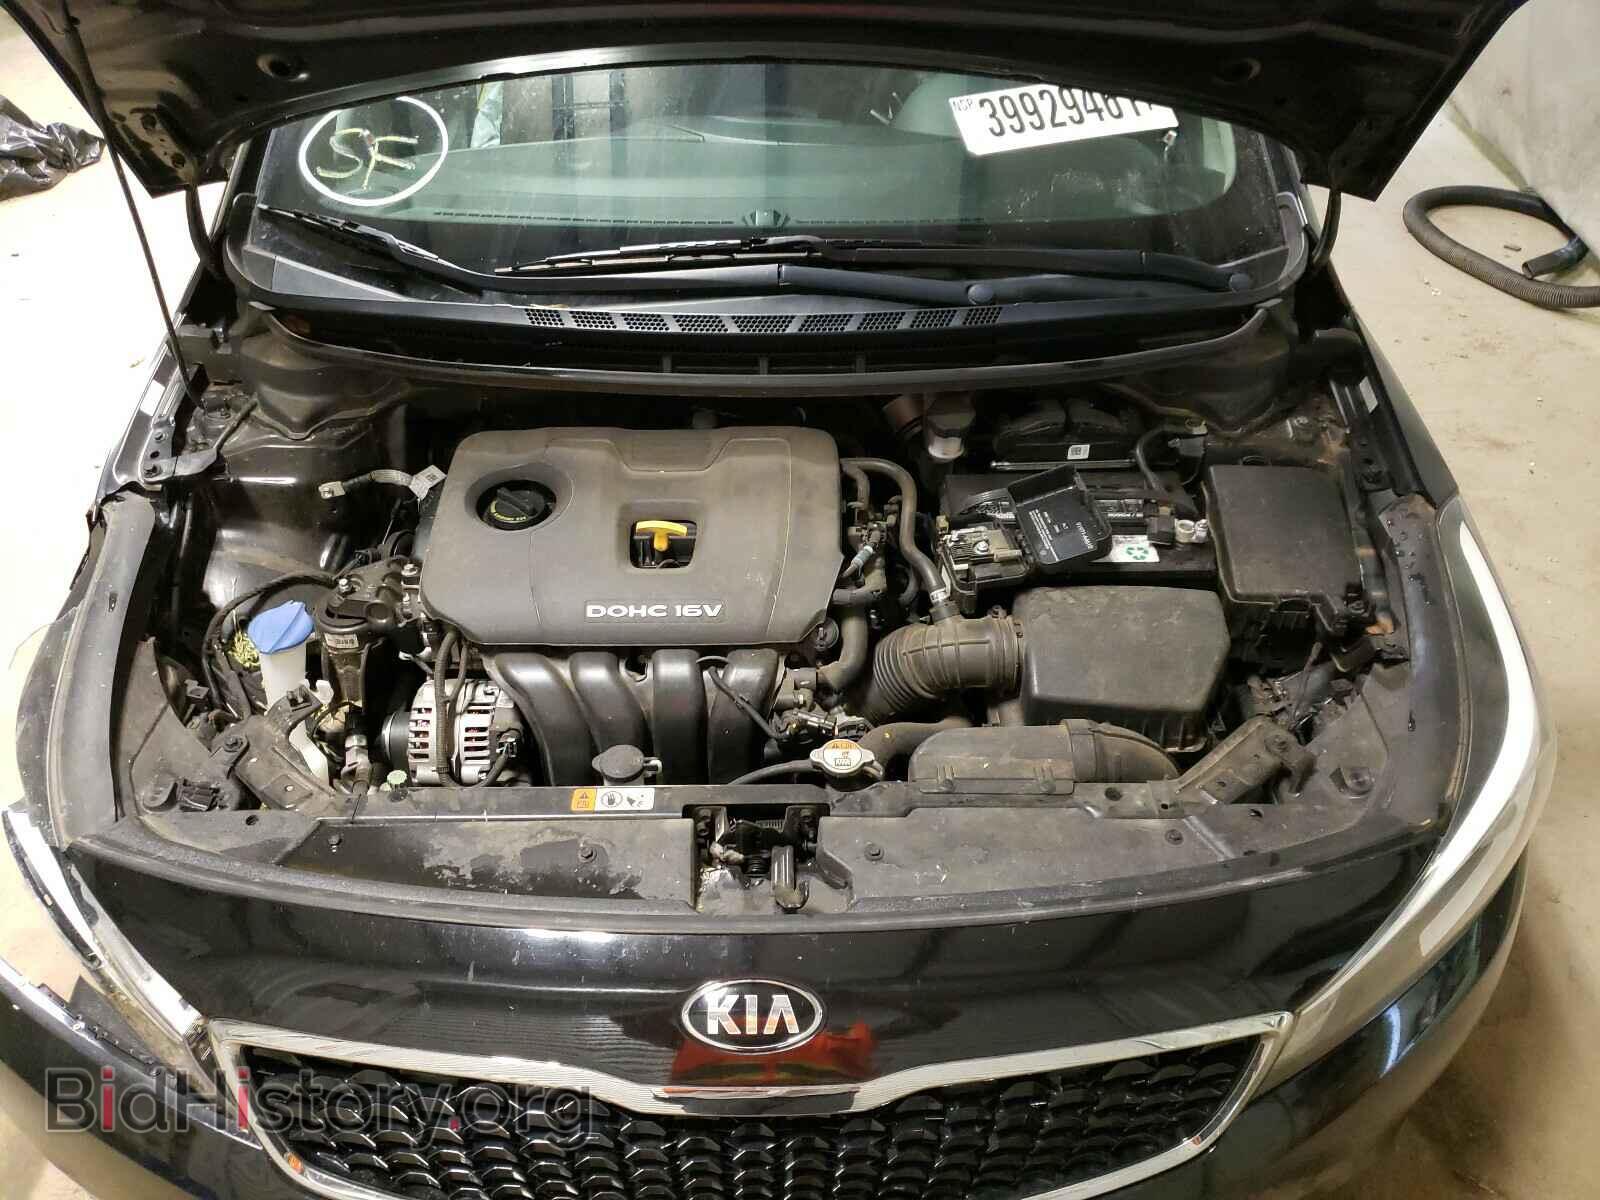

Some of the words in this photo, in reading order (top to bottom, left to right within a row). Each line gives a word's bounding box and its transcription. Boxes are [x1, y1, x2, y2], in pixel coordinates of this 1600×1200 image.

[586, 604, 667, 618] DOHC
[676, 604, 723, 618] 16V
[706, 993, 801, 1035] KIA
